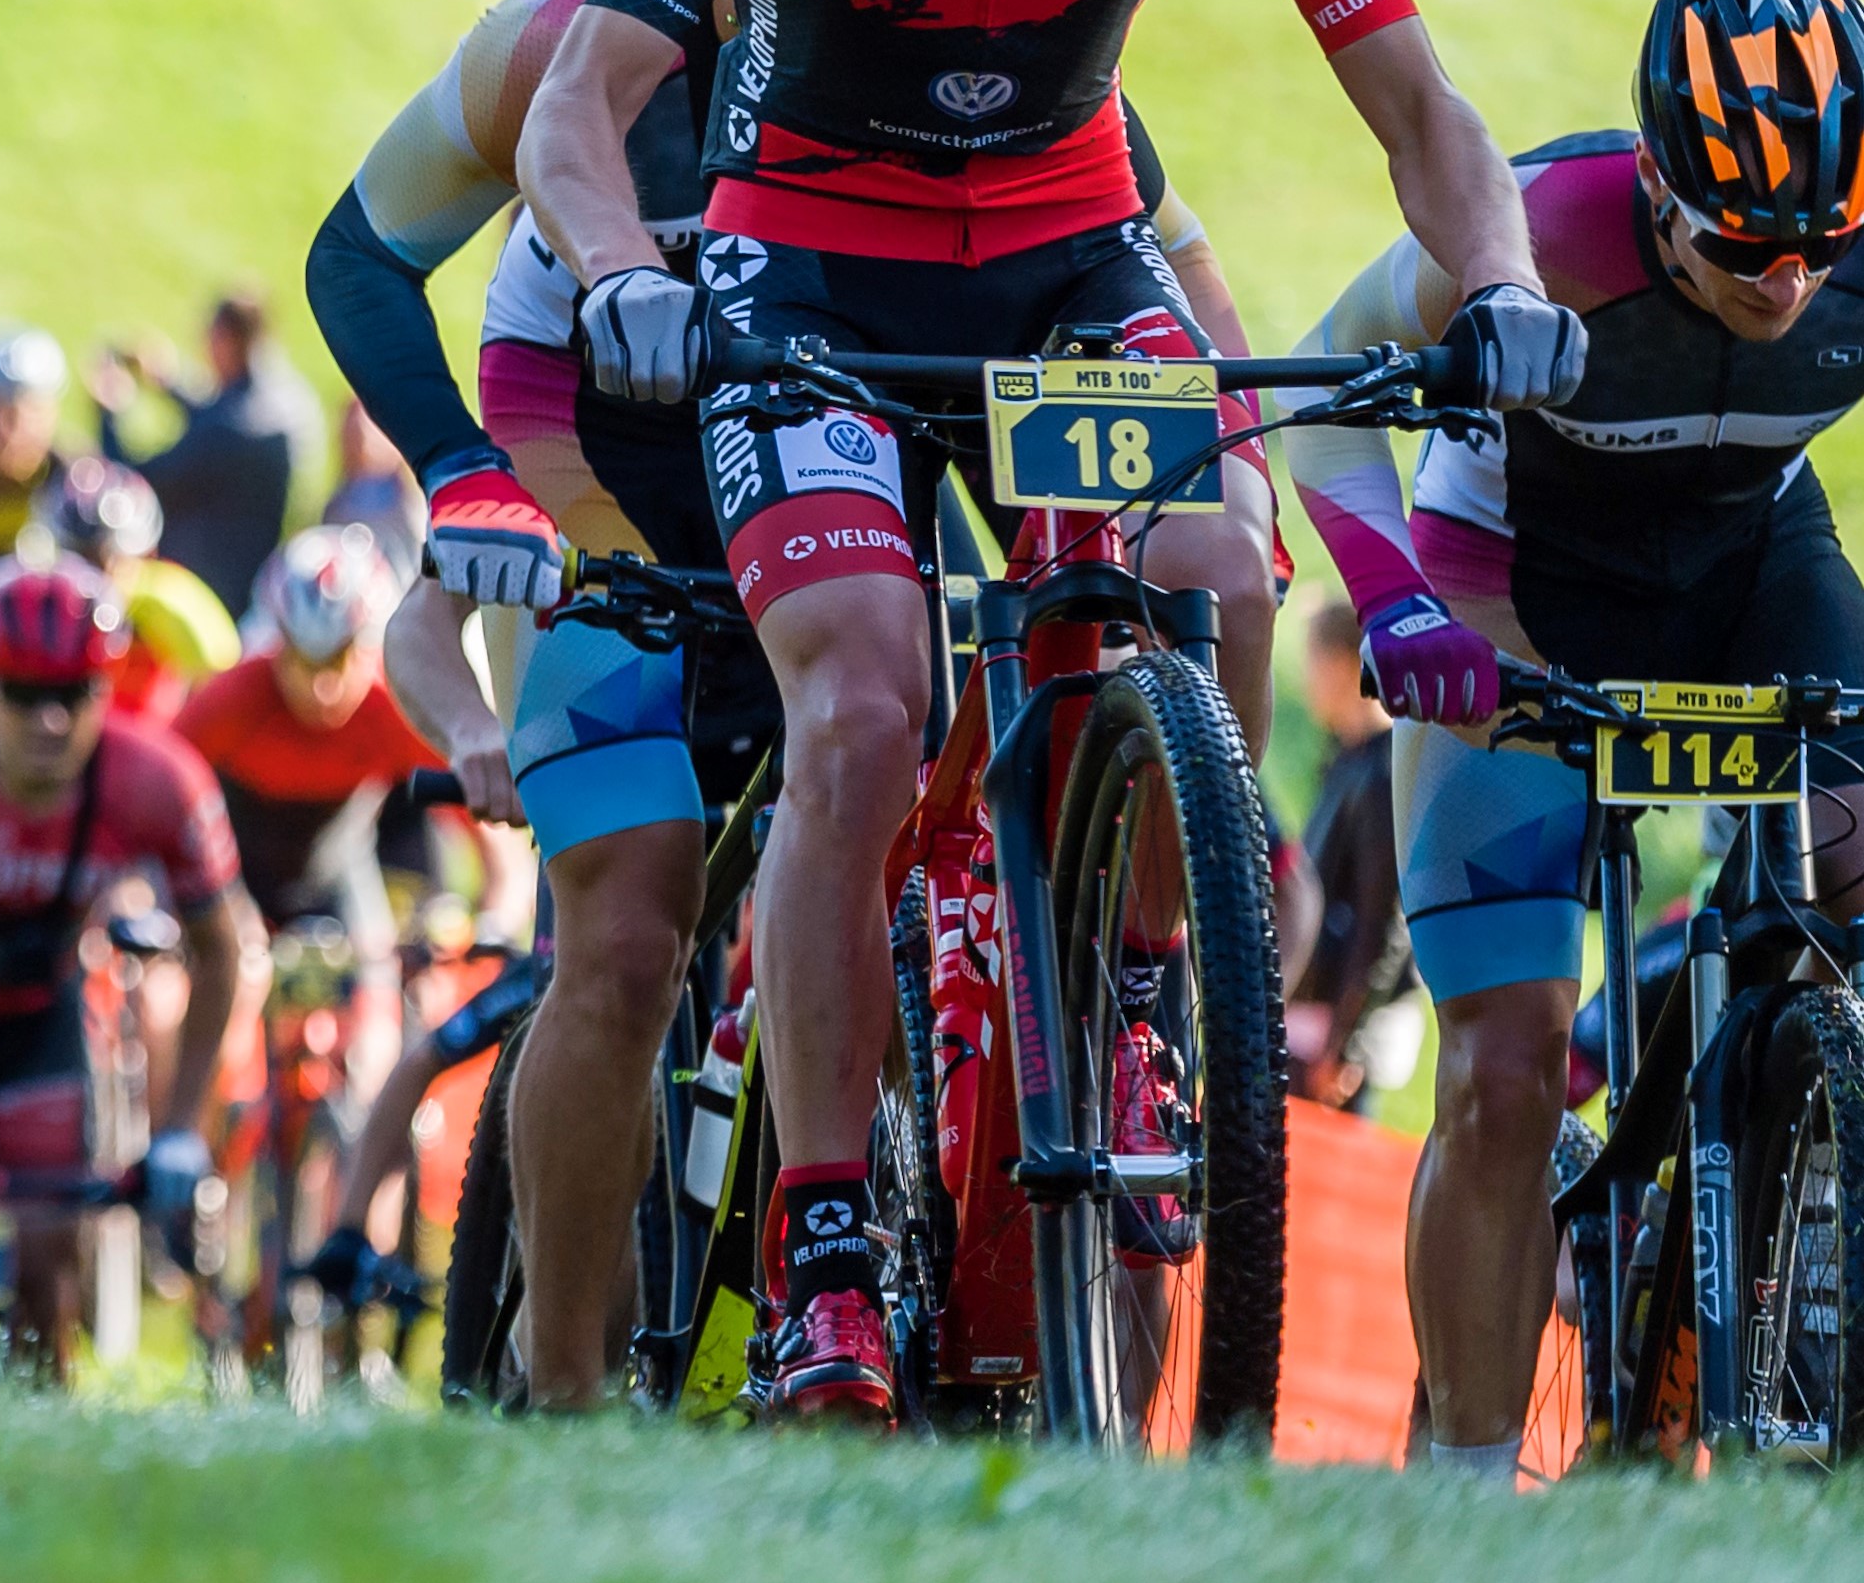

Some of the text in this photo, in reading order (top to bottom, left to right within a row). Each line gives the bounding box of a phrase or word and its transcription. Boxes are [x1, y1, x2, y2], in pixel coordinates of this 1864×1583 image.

[869, 118, 1054, 150] Komerctransports
[997, 375, 1034, 386] MTB
[1076, 370, 1151, 390] MTB 100
[997, 385, 1035, 397] 100
[1064, 417, 1154, 491] 18
[1676, 691, 1744, 709] MTB 100
[1641, 731, 1760, 786] 114
